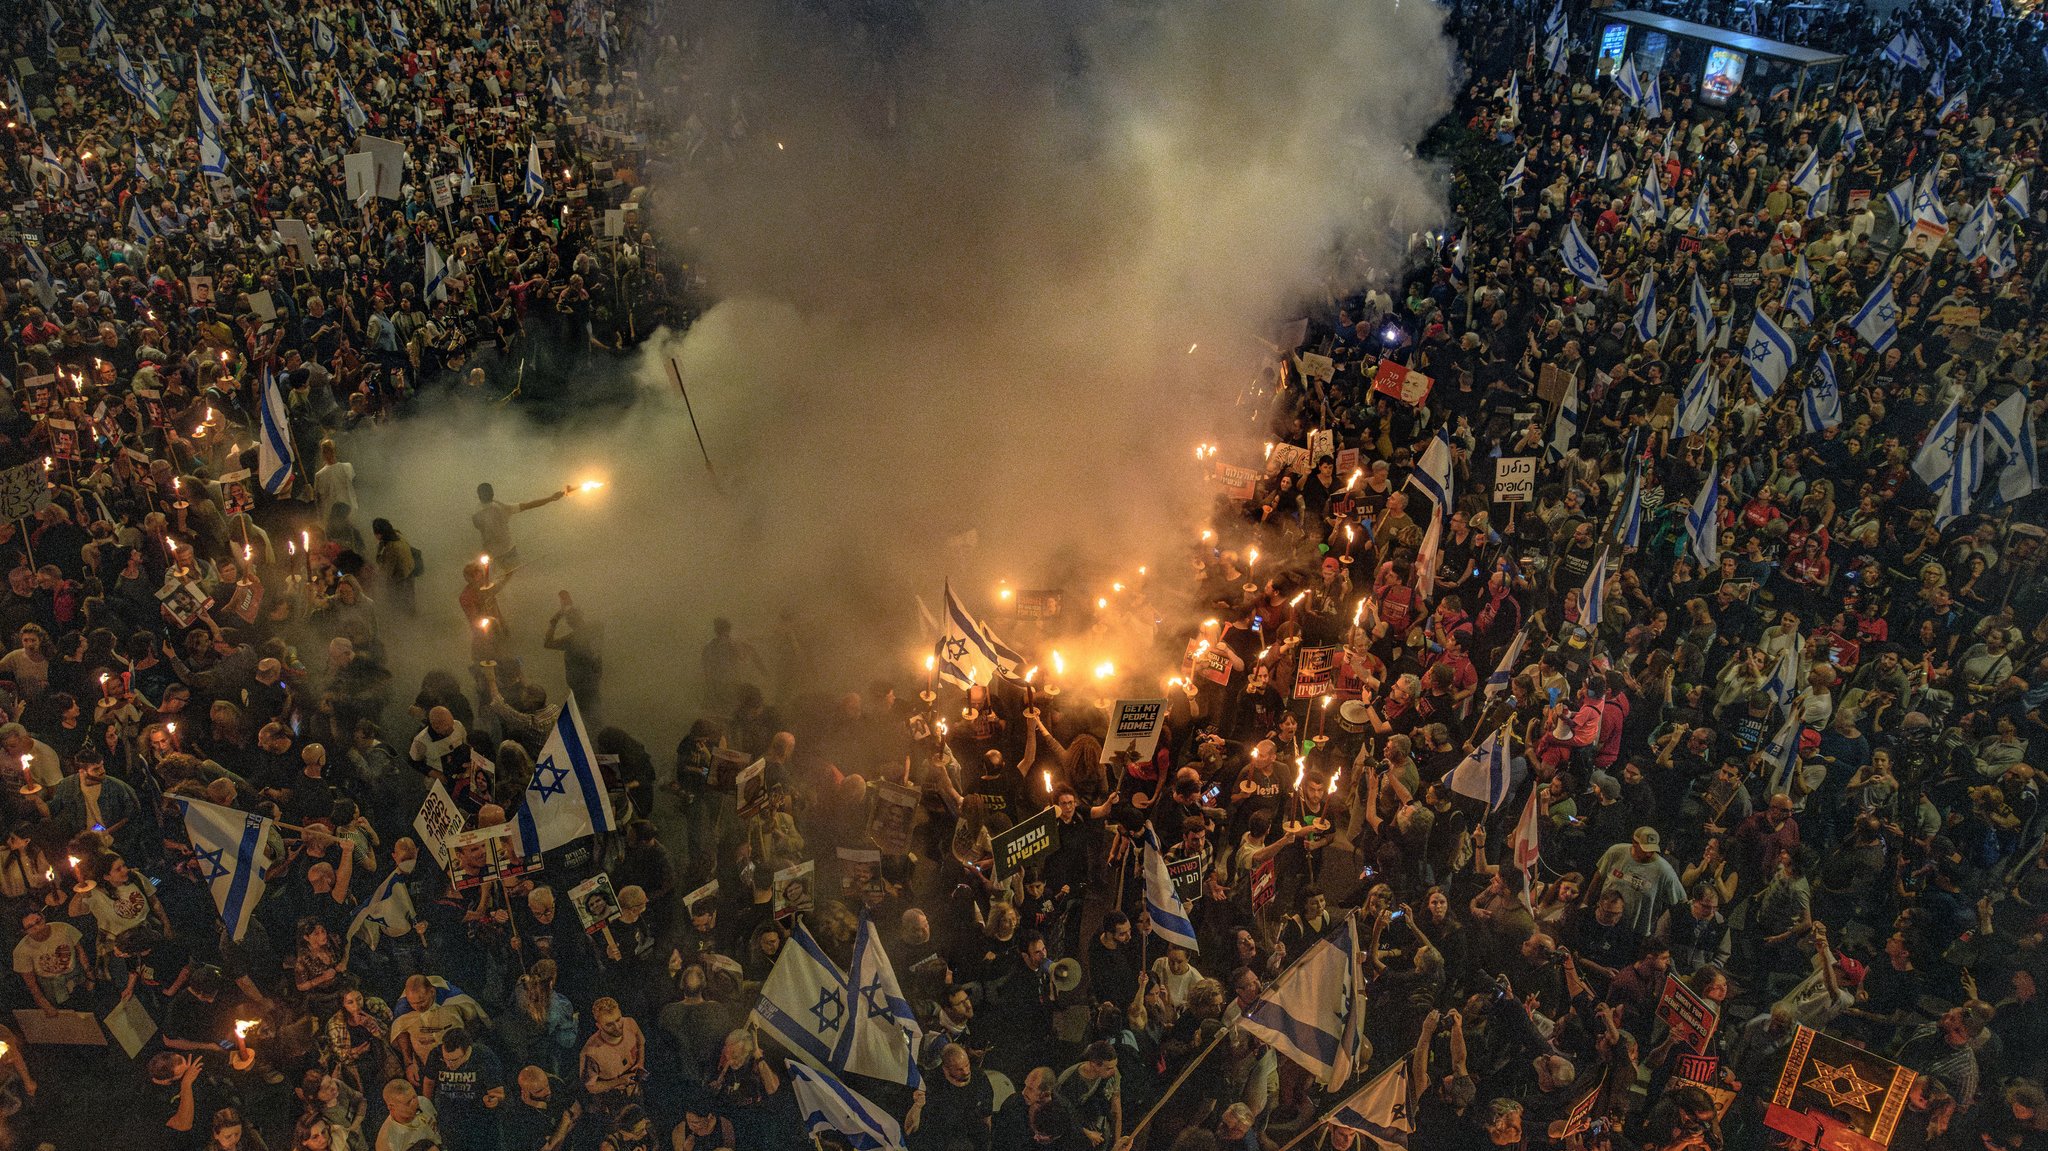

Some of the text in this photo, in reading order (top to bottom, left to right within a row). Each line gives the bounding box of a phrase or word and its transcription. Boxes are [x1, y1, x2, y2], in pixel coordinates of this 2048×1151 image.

[1389, 371, 1399, 380] מר
[1379, 377, 1397, 388] קלון
[1500, 460, 1530, 477] כולנו
[1494, 479, 1533, 492] חטופים
[1124, 704, 1159, 713] GET MY
[1122, 712, 1157, 721] PEOPLE
[1118, 721, 1155, 731] HOME!
[1007, 824, 1046, 855] עסקה
[1006, 835, 1050, 868] עכשיו!
[1168, 861, 1198, 876] כשהוא
[1186, 872, 1199, 884] הם
[1663, 994, 1708, 1038] BEING KIDNAPPED
[1691, 1006, 1704, 1020] FOR
[1682, 1058, 1717, 1083] STOP
